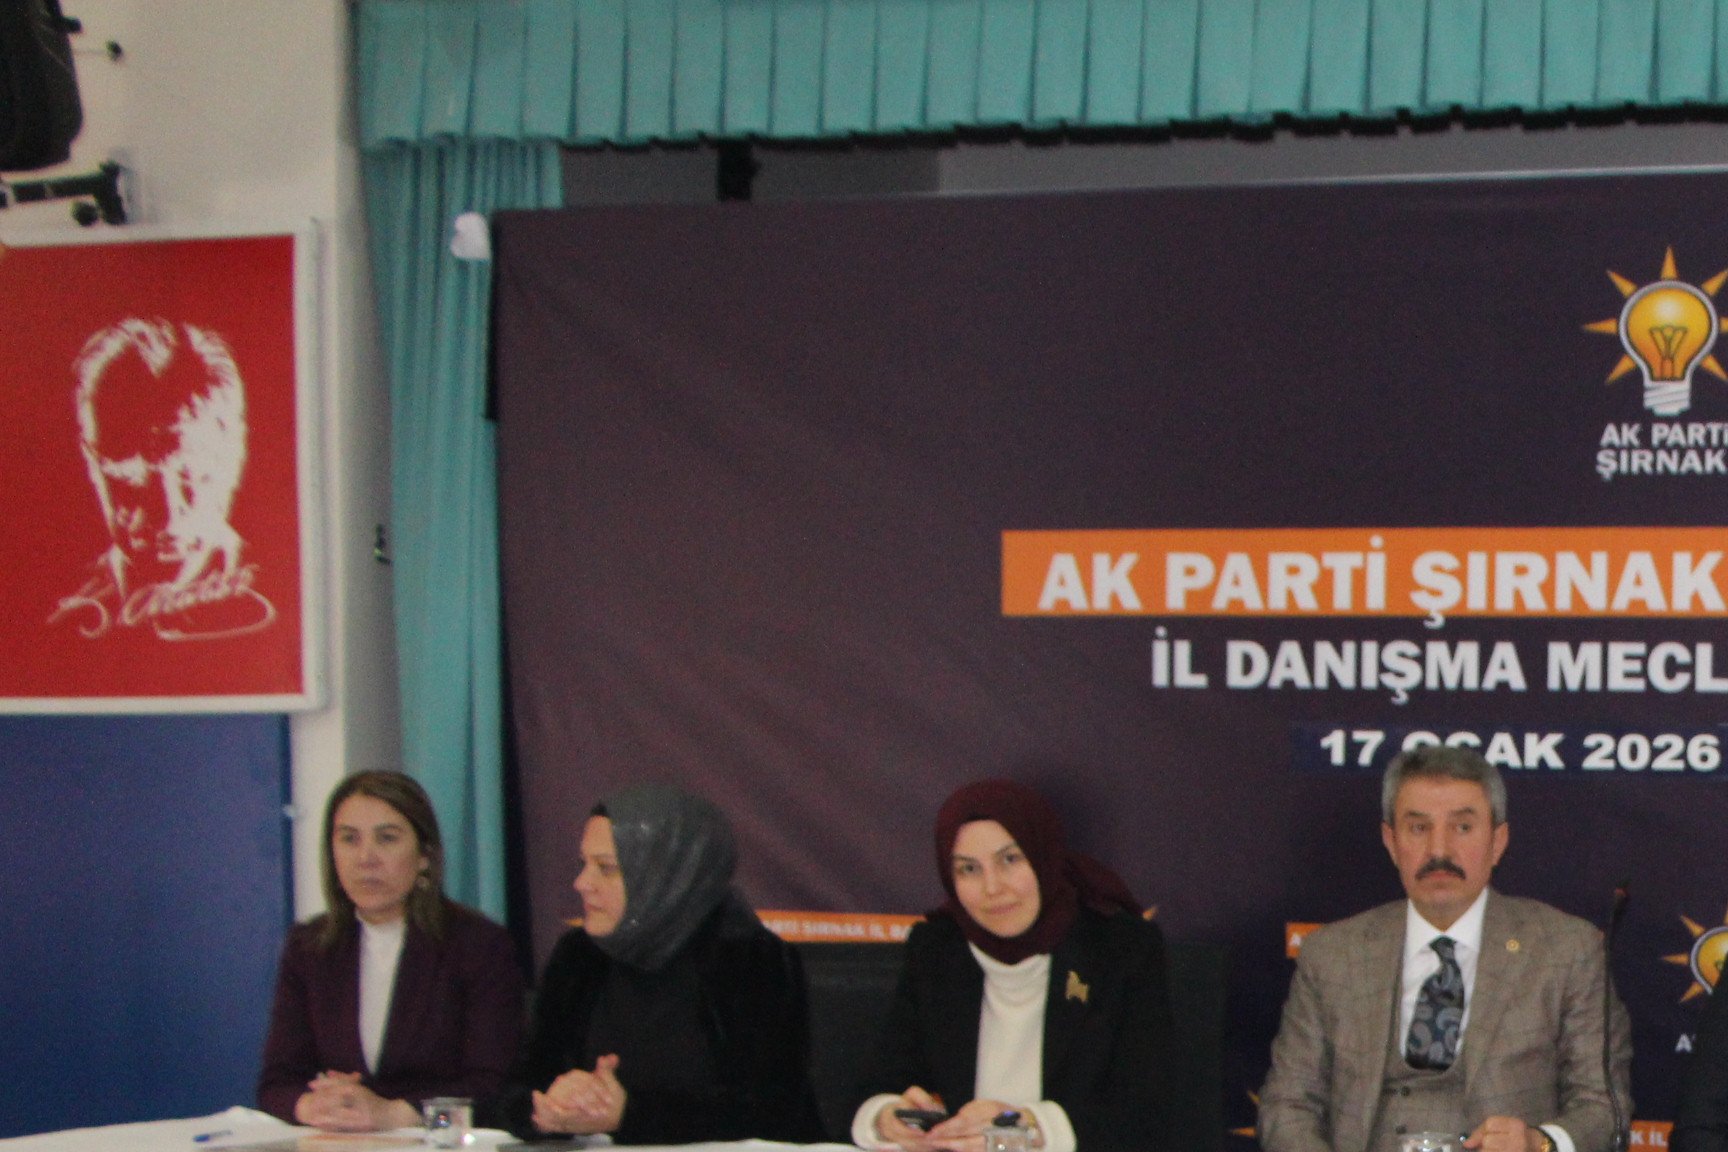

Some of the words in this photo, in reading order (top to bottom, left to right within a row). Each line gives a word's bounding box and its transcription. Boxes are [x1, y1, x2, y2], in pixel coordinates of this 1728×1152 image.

[1600, 424, 1640, 448] AK
[1596, 449, 1727, 480] ŞIRNAK
[1038, 552, 1142, 611] AK
[1165, 535, 1387, 611] PARTİ
[1409, 550, 1727, 629] ŞIRNAK
[1151, 626, 1208, 689] İL
[1226, 639, 1527, 704] DANIŞMA
[1320, 729, 1385, 766] 17
[1582, 732, 1721, 771] 2026
